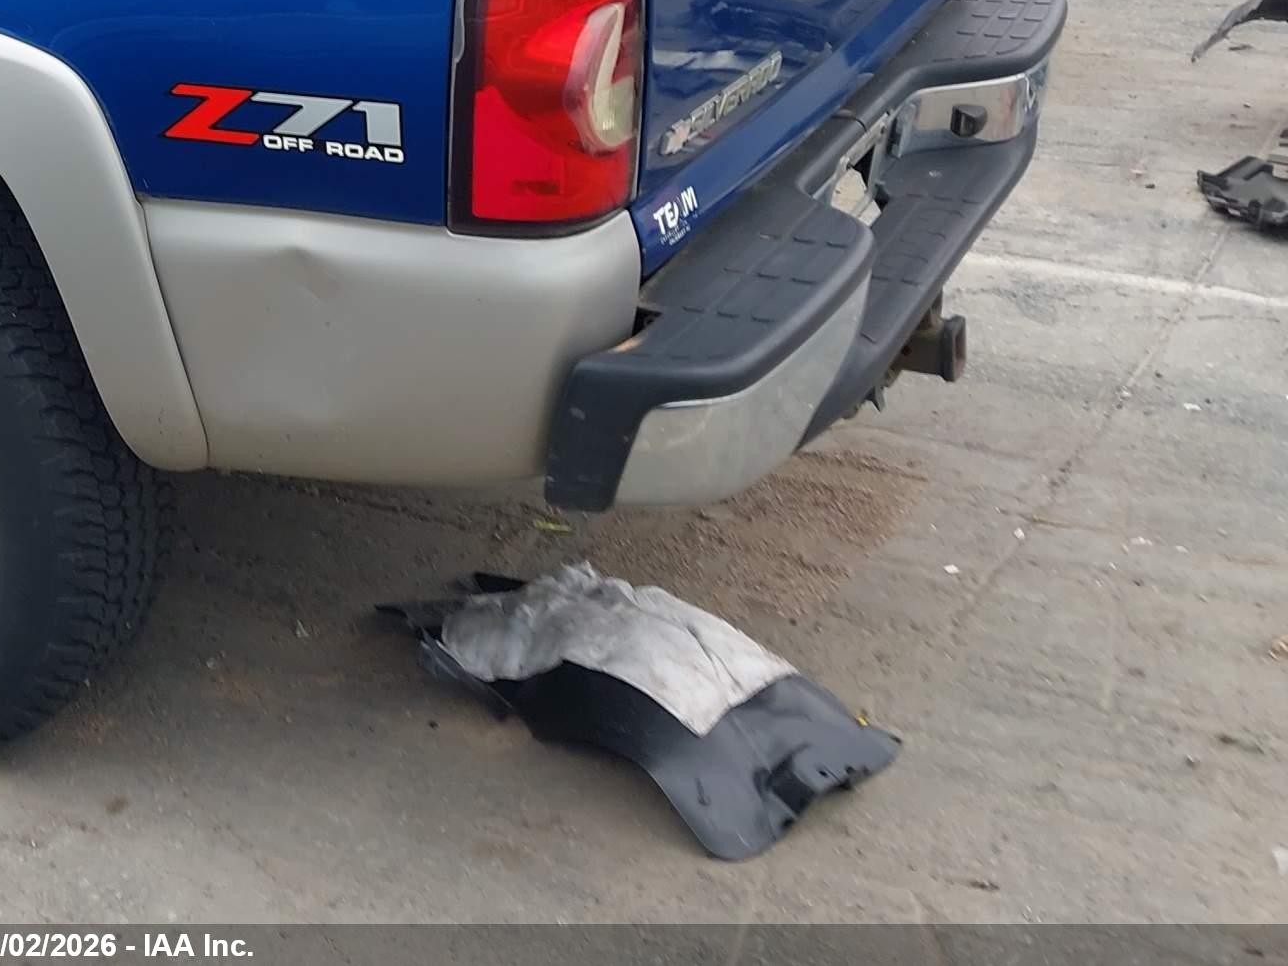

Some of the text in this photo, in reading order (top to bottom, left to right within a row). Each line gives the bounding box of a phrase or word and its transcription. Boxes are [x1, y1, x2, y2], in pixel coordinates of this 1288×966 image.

[164, 83, 402, 147] Z71
[262, 134, 405, 163] OFF ROAD
